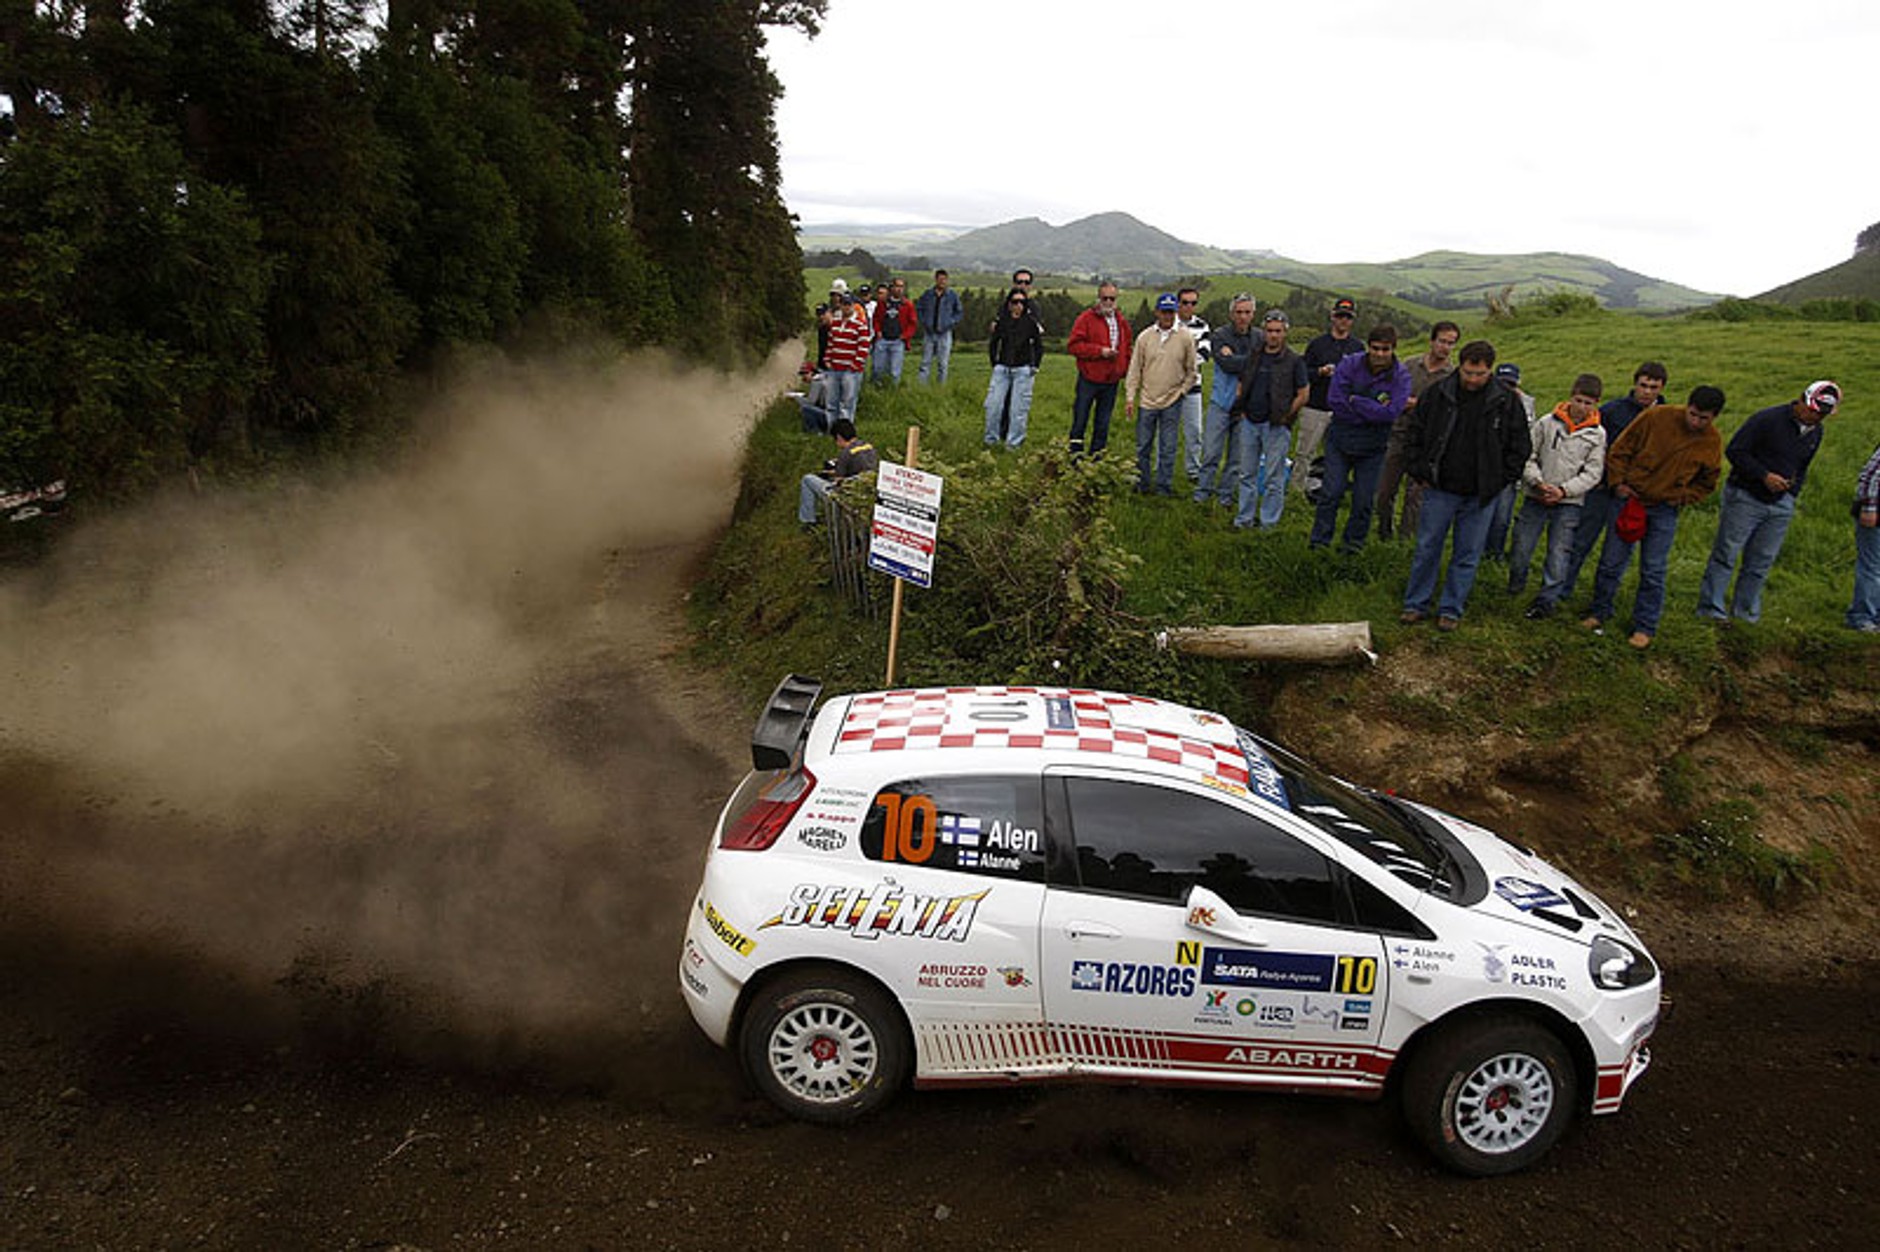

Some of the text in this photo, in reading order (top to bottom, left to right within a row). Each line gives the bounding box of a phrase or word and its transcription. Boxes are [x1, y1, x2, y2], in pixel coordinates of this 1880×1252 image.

[876, 793, 937, 863] 10
[987, 820, 1038, 851] Alen
[980, 854, 1021, 871] Alanne
[1177, 941, 1200, 964] N
[919, 964, 988, 976] ABRUZZO
[1213, 964, 1259, 979] SATA
[1412, 960, 1440, 972] Alen
[1511, 954, 1556, 971] ADLER
[1340, 957, 1377, 994] 10
[1511, 972, 1567, 991] PLASTIC
[1224, 1048, 1358, 1068] ABARTH
